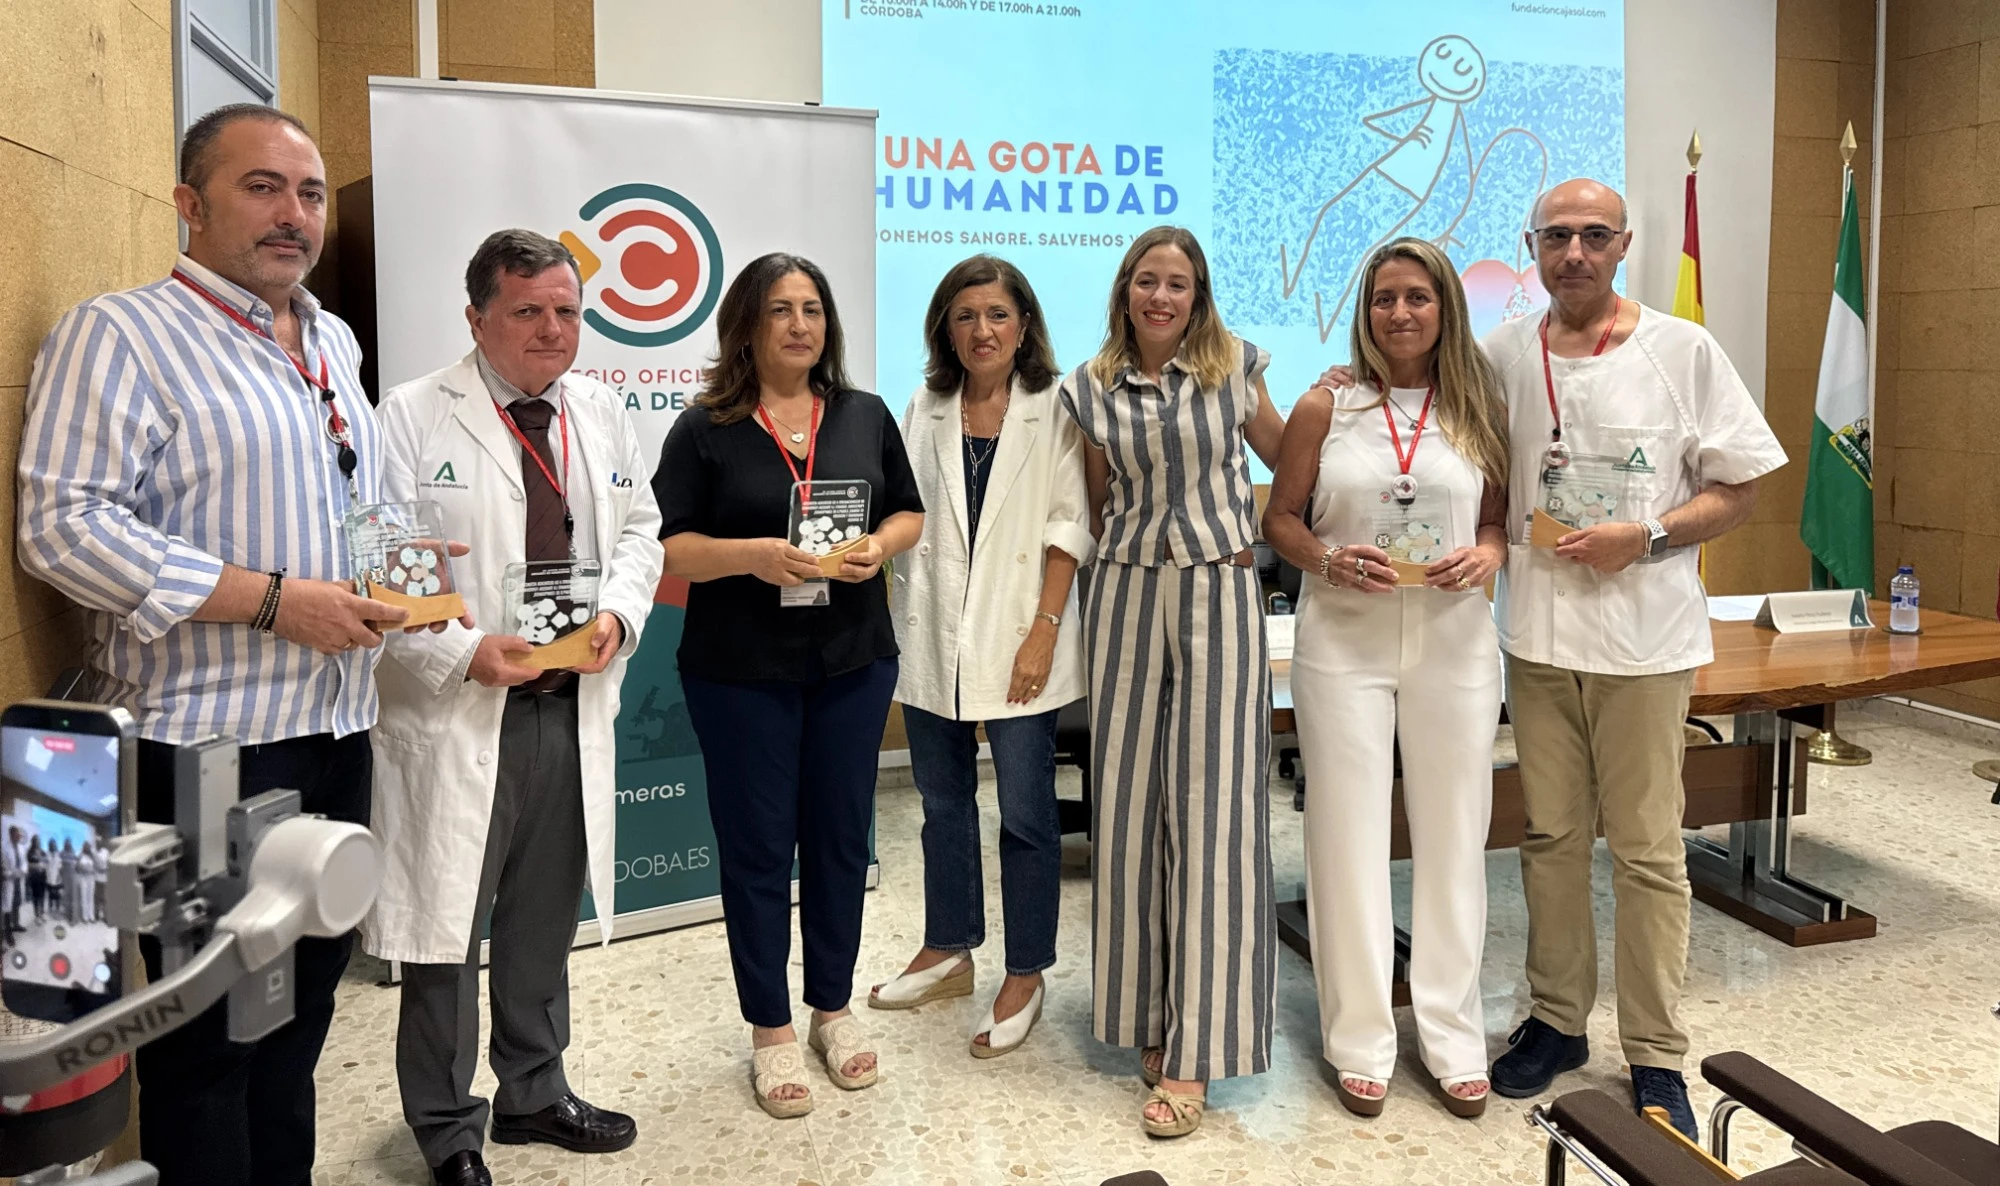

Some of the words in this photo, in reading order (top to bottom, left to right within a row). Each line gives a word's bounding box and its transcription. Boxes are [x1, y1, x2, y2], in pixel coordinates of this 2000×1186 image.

[970, 0, 978, 11] Y
[980, 0, 996, 12] DE
[998, 2, 1033, 14] 17.00h
[1036, 4, 1045, 15] A
[1046, 5, 1081, 17] 21.00h
[1511, 2, 1606, 18] fundacioncajasol.com
[885, 135, 976, 172] UNA
[988, 140, 1102, 176] GOTA
[1115, 144, 1164, 178] DE
[876, 229, 954, 245] ONEMOS
[960, 230, 1033, 246] SANGRE.
[1038, 232, 1124, 248] SALVEMOS
[651, 391, 684, 410] DE
[54, 993, 185, 1074] RONIN
